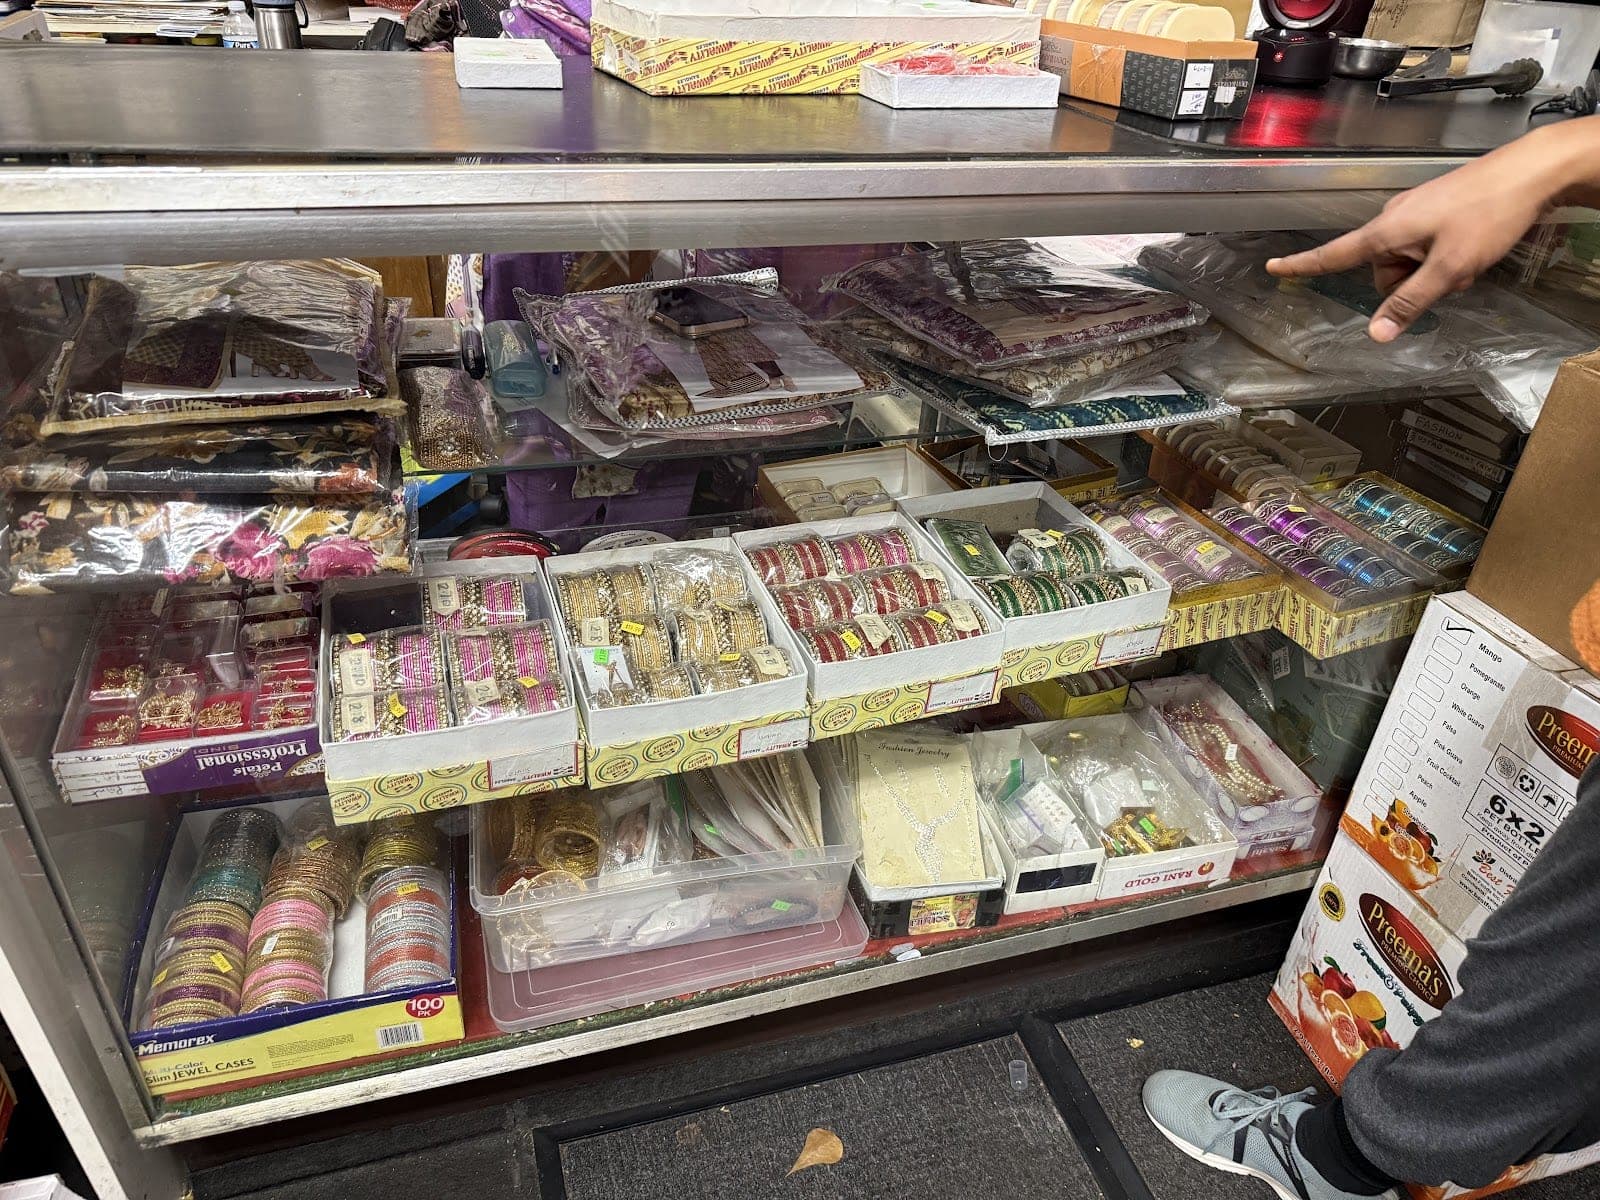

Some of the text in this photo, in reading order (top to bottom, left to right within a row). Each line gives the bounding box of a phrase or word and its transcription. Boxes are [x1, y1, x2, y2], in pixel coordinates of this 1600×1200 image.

[1415, 416, 1463, 440] FASHION
[1478, 643, 1502, 664] Mango
[1469, 663, 1506, 692] Pomegranate
[1460, 683, 1481, 701] Orange
[1451, 702, 1485, 730] White Guava
[1442, 721, 1457, 736] Falsa
[766, 741, 792, 751] KWALITY
[878, 743, 951, 760] Fashion Jewelry
[1433, 739, 1463, 765] Pink Guava
[196, 743, 309, 770] Professional
[234, 761, 283, 776] Petals
[1426, 758, 1440, 773] Fruit
[386, 776, 415, 789] KWALITY
[522, 770, 552, 781] KWALITY
[1417, 774, 1433, 790] Peach
[334, 794, 362, 808] KWALITY
[1409, 790, 1427, 808] Apple
[1476, 812, 1493, 828] Keep
[1481, 827, 1512, 853] Product
[1483, 808, 1540, 856] PET BOTTLE
[1124, 877, 1160, 888] GOLD
[1163, 870, 1194, 882] RANI
[1479, 863, 1502, 885] Best
[1368, 901, 1443, 996] Preema's
[1384, 973, 1394, 990] &
[1408, 971, 1434, 1001] CHOICE
[407, 997, 445, 1012] 100
[417, 1010, 431, 1018] PK
[138, 1033, 217, 1056] Memorex
[145, 1058, 254, 1084] Slim JEWEL CASES
